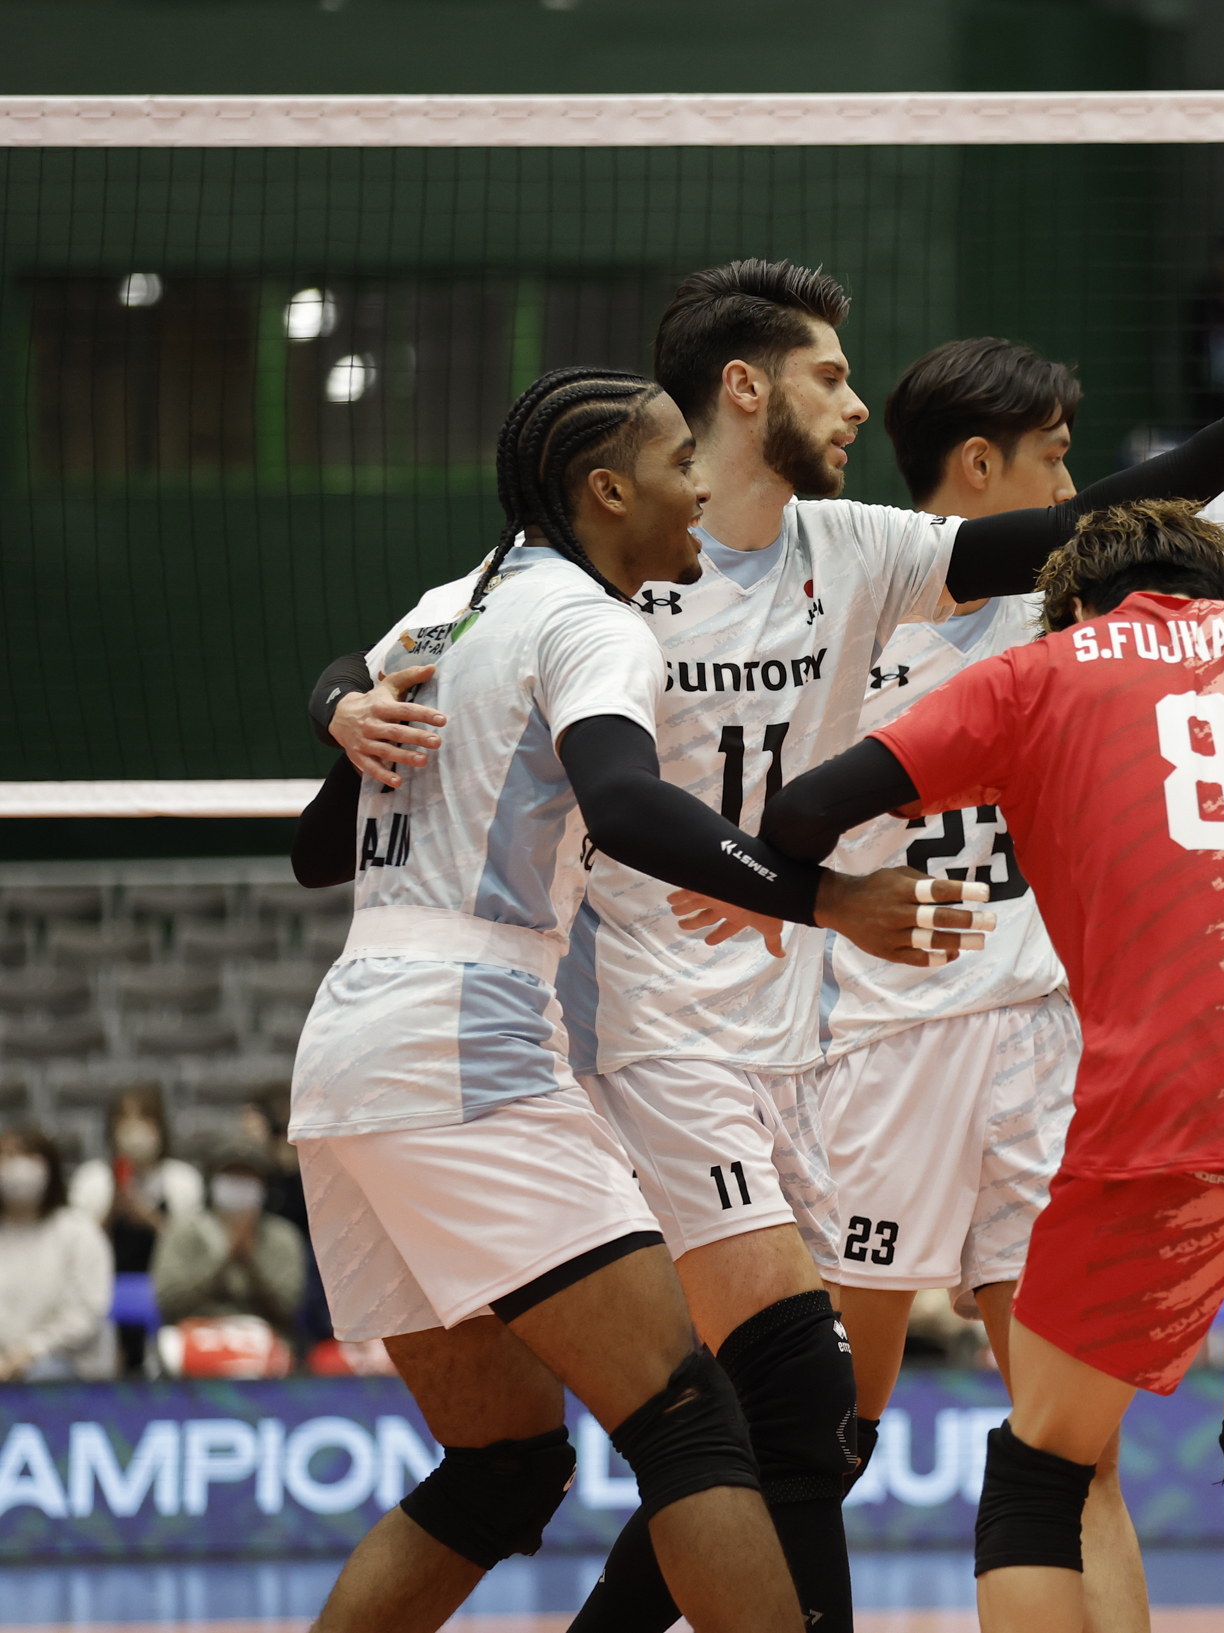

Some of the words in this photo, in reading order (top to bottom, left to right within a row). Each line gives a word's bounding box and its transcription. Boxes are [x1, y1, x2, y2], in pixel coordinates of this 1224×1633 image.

[717, 721, 790, 828] 11
[710, 1161, 752, 1210] 11
[844, 1215, 898, 1265] 23
